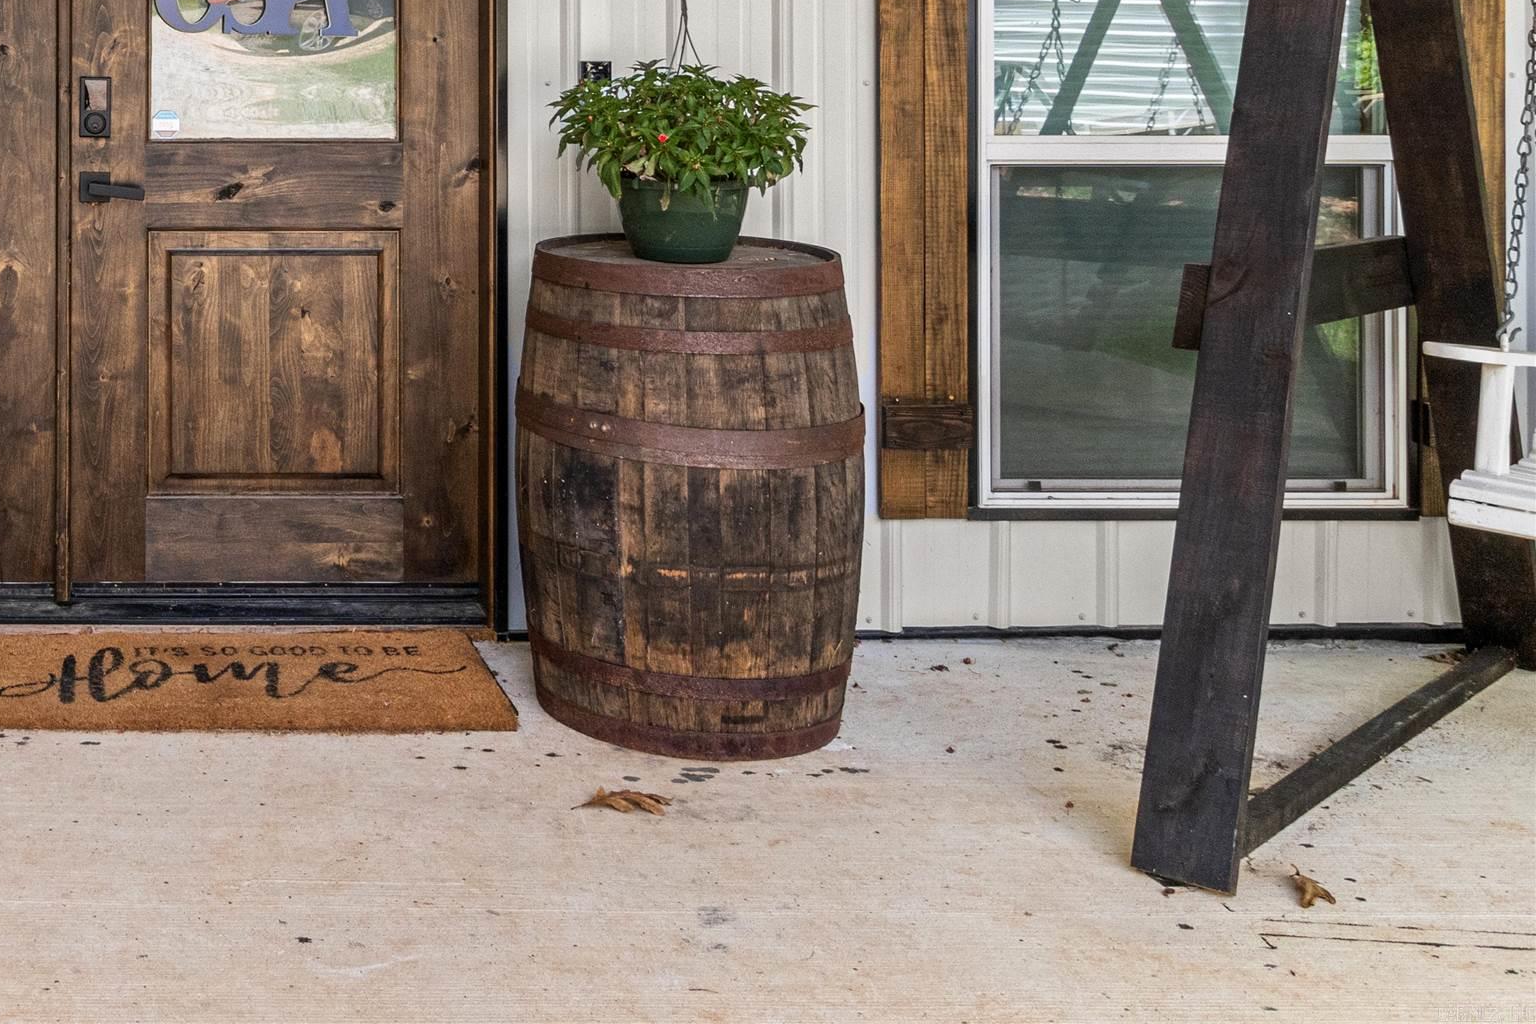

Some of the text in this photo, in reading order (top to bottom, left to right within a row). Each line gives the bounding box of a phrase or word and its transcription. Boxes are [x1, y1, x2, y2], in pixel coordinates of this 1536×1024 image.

[133, 645, 422, 657] IT'S SO GOOD TO BE
